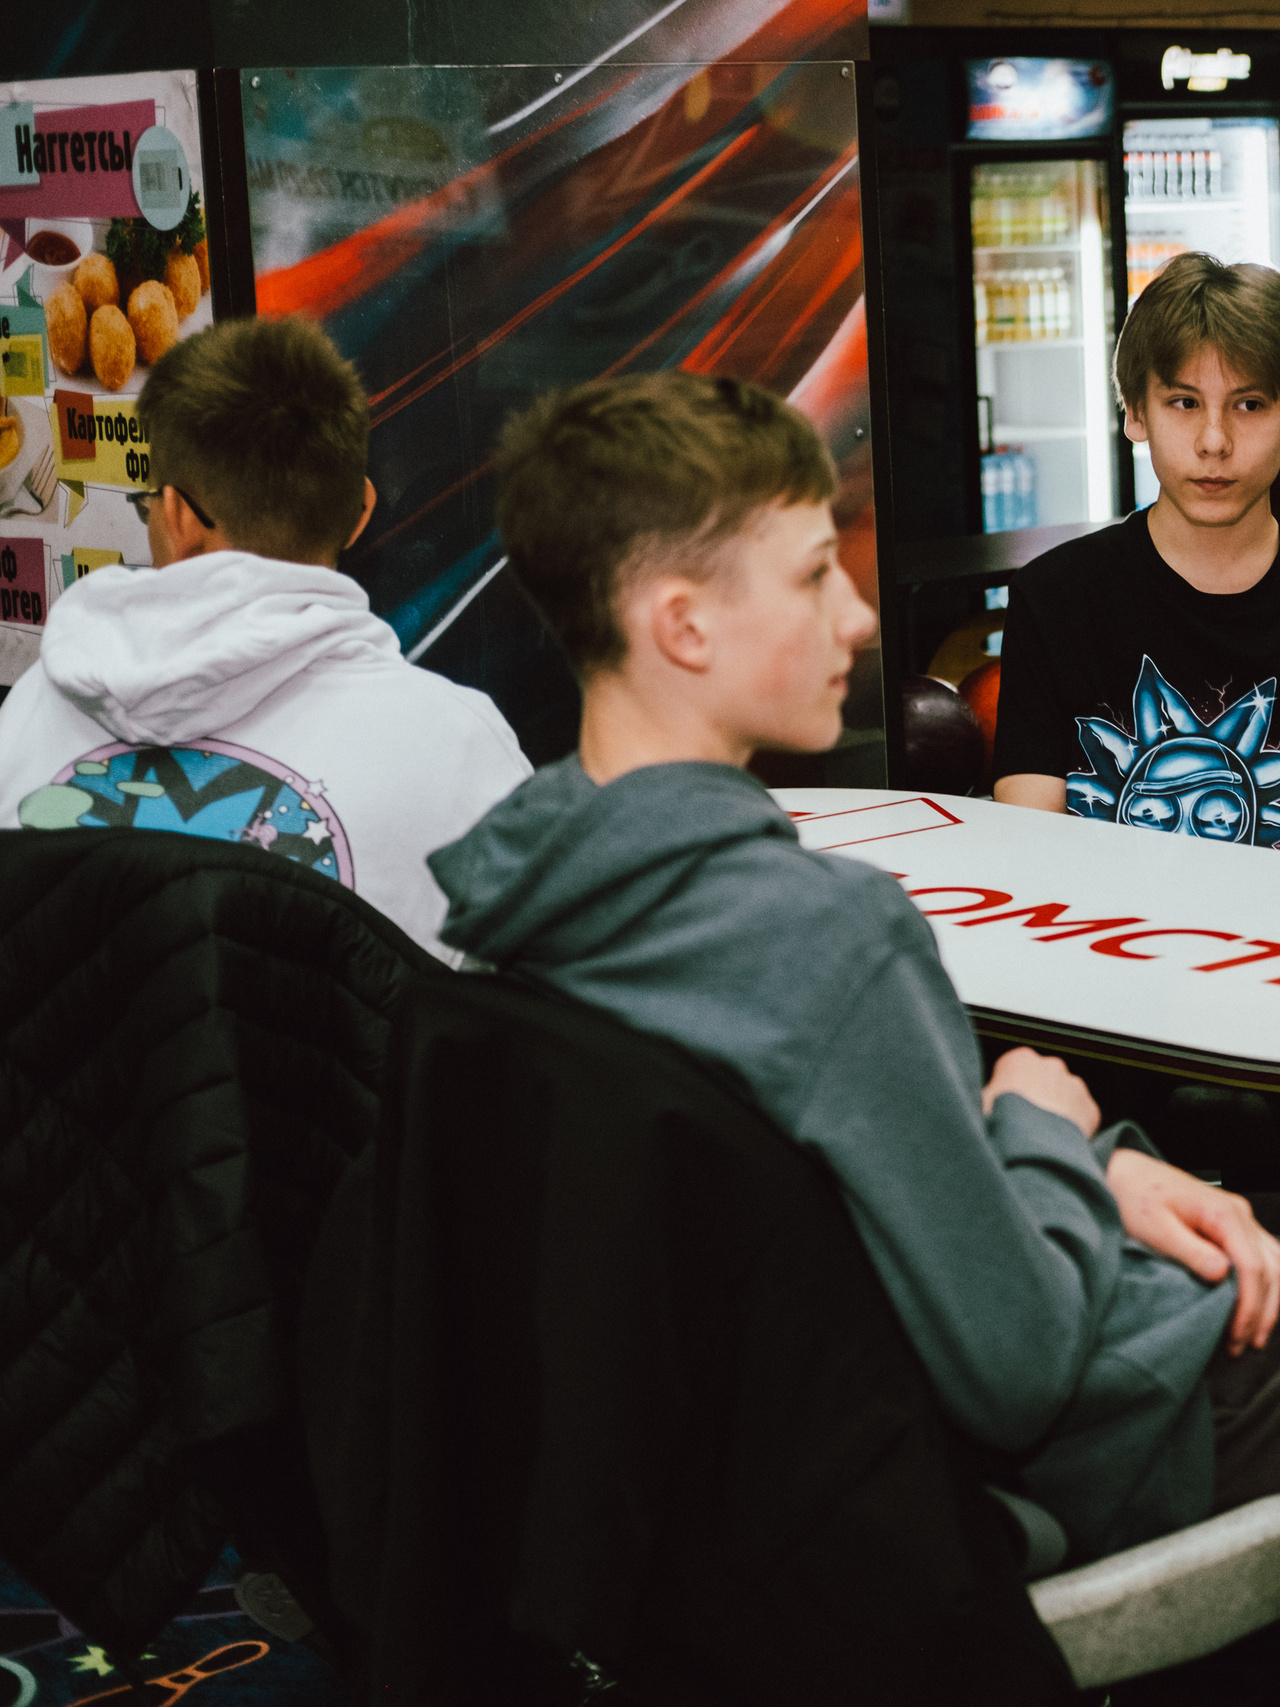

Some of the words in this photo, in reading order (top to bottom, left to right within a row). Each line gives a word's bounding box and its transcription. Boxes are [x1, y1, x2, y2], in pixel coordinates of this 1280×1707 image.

[15, 124, 132, 173] Наггетсы
[0, 316, 10, 339] е
[66, 407, 149, 445] Картофел
[126, 449, 149, 482] фр
[0, 545, 17, 582] ф
[0, 588, 42, 624] ргер
